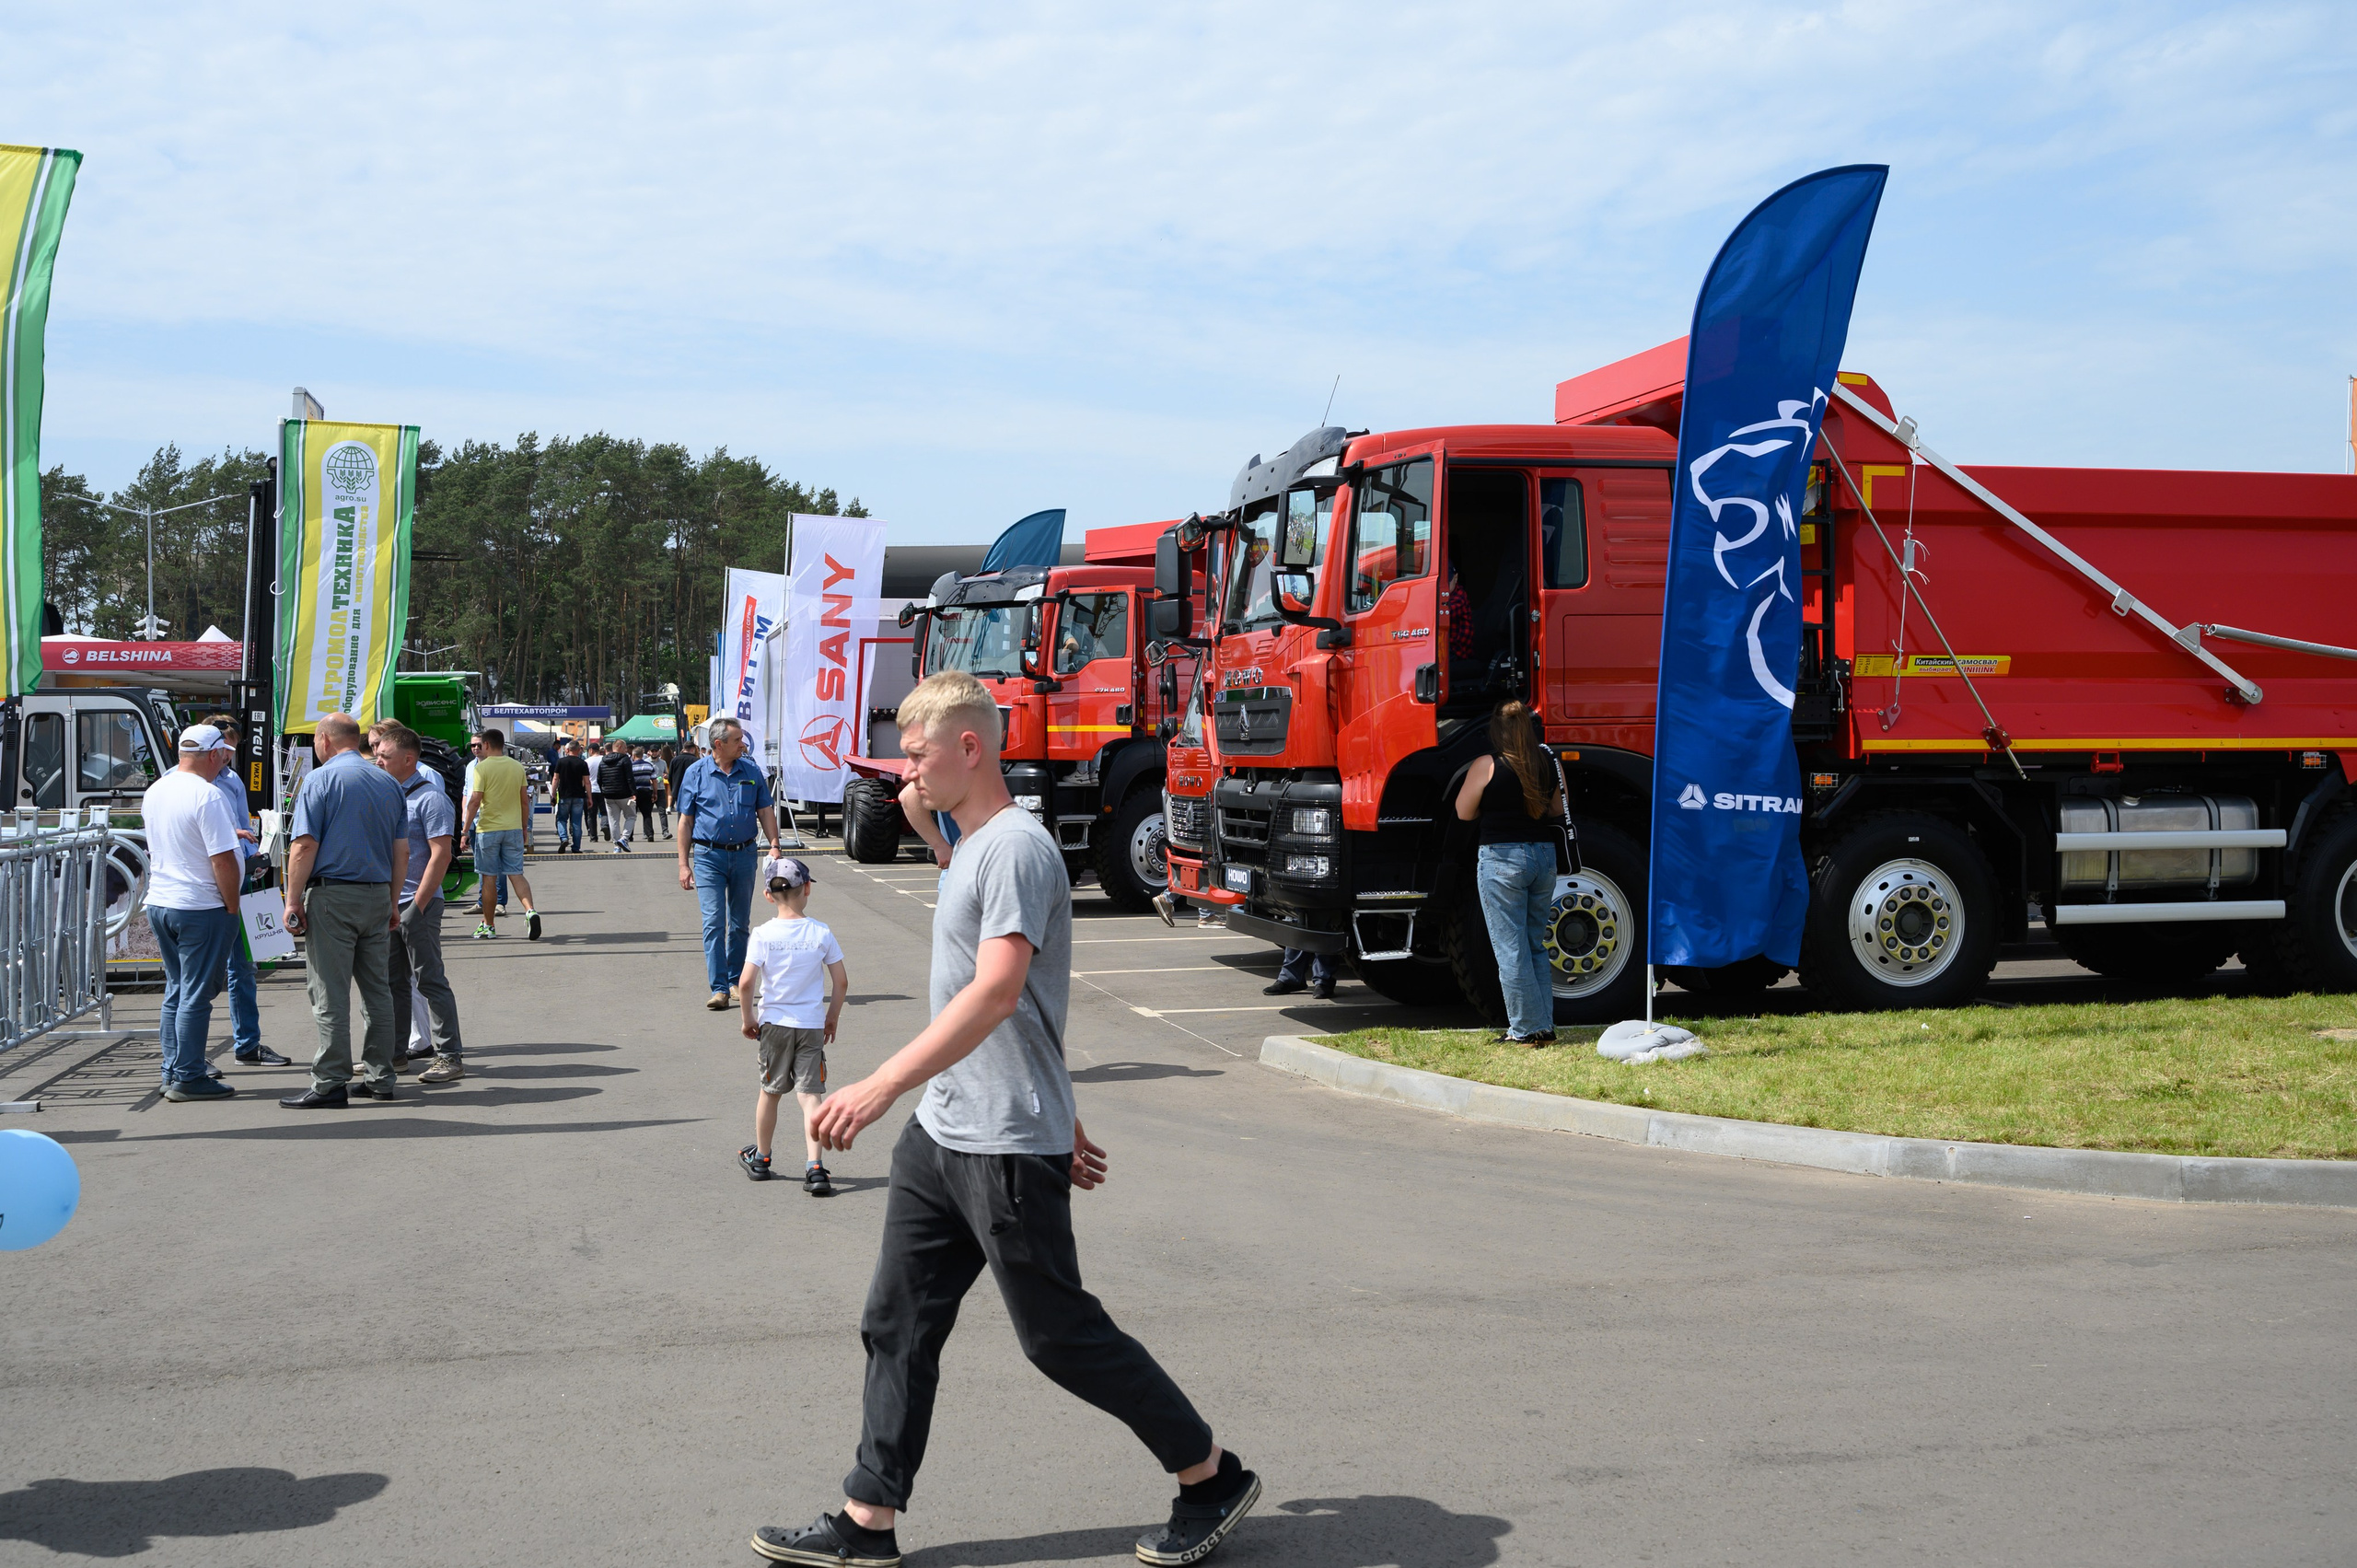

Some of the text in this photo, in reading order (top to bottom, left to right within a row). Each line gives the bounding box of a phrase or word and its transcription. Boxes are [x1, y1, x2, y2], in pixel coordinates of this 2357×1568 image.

[334, 494, 366, 503] agro.su
[352, 609, 361, 629] для
[815, 552, 854, 702] SANY
[1411, 627, 1430, 637] 480
[86, 650, 172, 662] BELSHINA
[1224, 667, 1263, 687] HOWO
[251, 762, 261, 791] VMX.BY
[1178, 775, 1202, 787] HOWO
[1562, 794, 1571, 825] PINEAPPLE
[1227, 868, 1248, 885] HOWO
[1180, 1528, 1225, 1562] crocs
